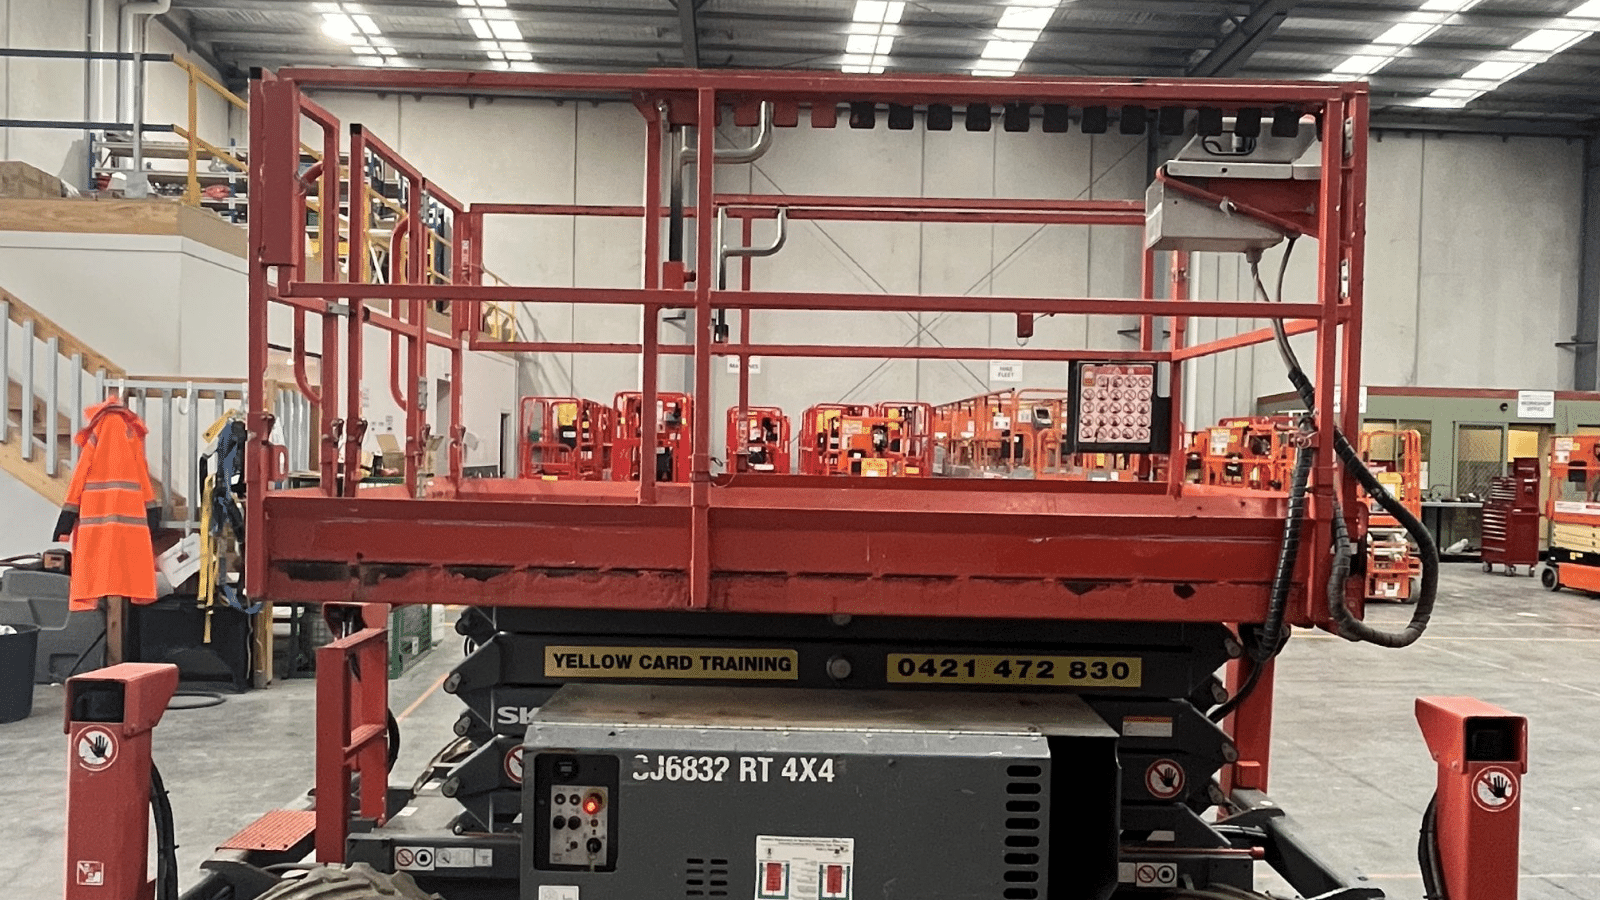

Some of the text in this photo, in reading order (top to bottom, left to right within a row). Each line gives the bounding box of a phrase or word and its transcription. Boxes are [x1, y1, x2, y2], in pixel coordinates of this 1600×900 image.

[553, 653, 791, 672] YELLOW CARD TRAINING
[898, 658, 1130, 680] 0421 472 830
[739, 756, 774, 782] RT
[781, 757, 835, 783] 4X4
